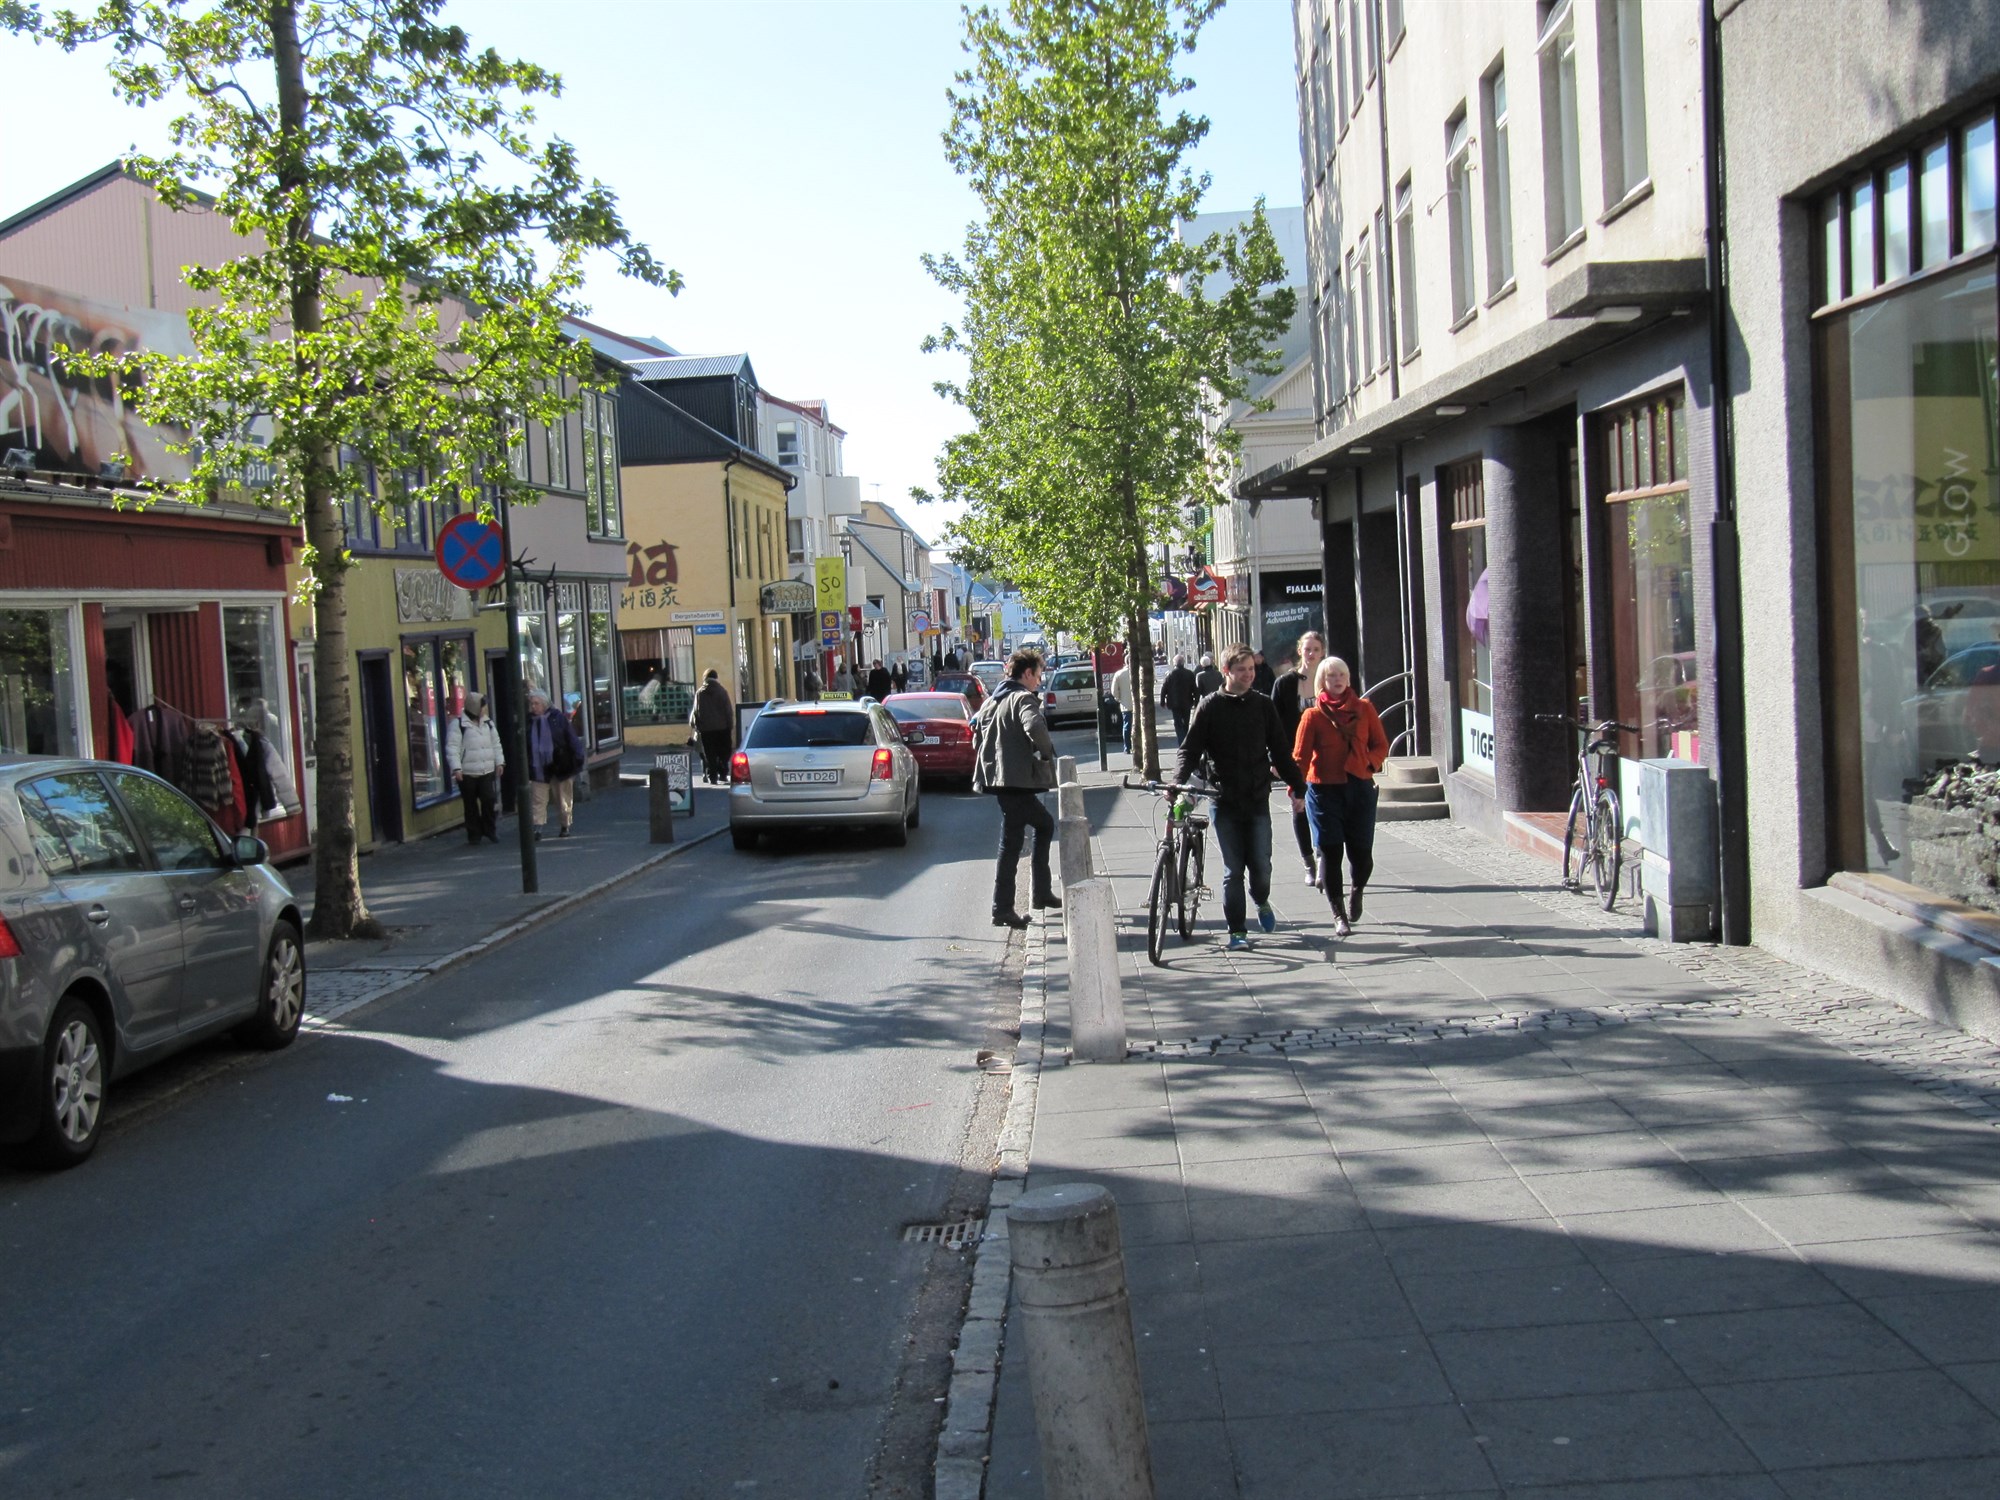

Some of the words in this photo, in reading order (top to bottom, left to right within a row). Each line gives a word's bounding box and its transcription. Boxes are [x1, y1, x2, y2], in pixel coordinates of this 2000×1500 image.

[1943, 447, 1970, 557] GLOW
[820, 576, 841, 593] 50
[825, 617, 836, 625] 30
[1265, 609, 1290, 618] Nature
[1266, 614, 1304, 624] Adventure!
[1470, 728, 1494, 761] TIGE
[656, 754, 689, 770] NAKED
